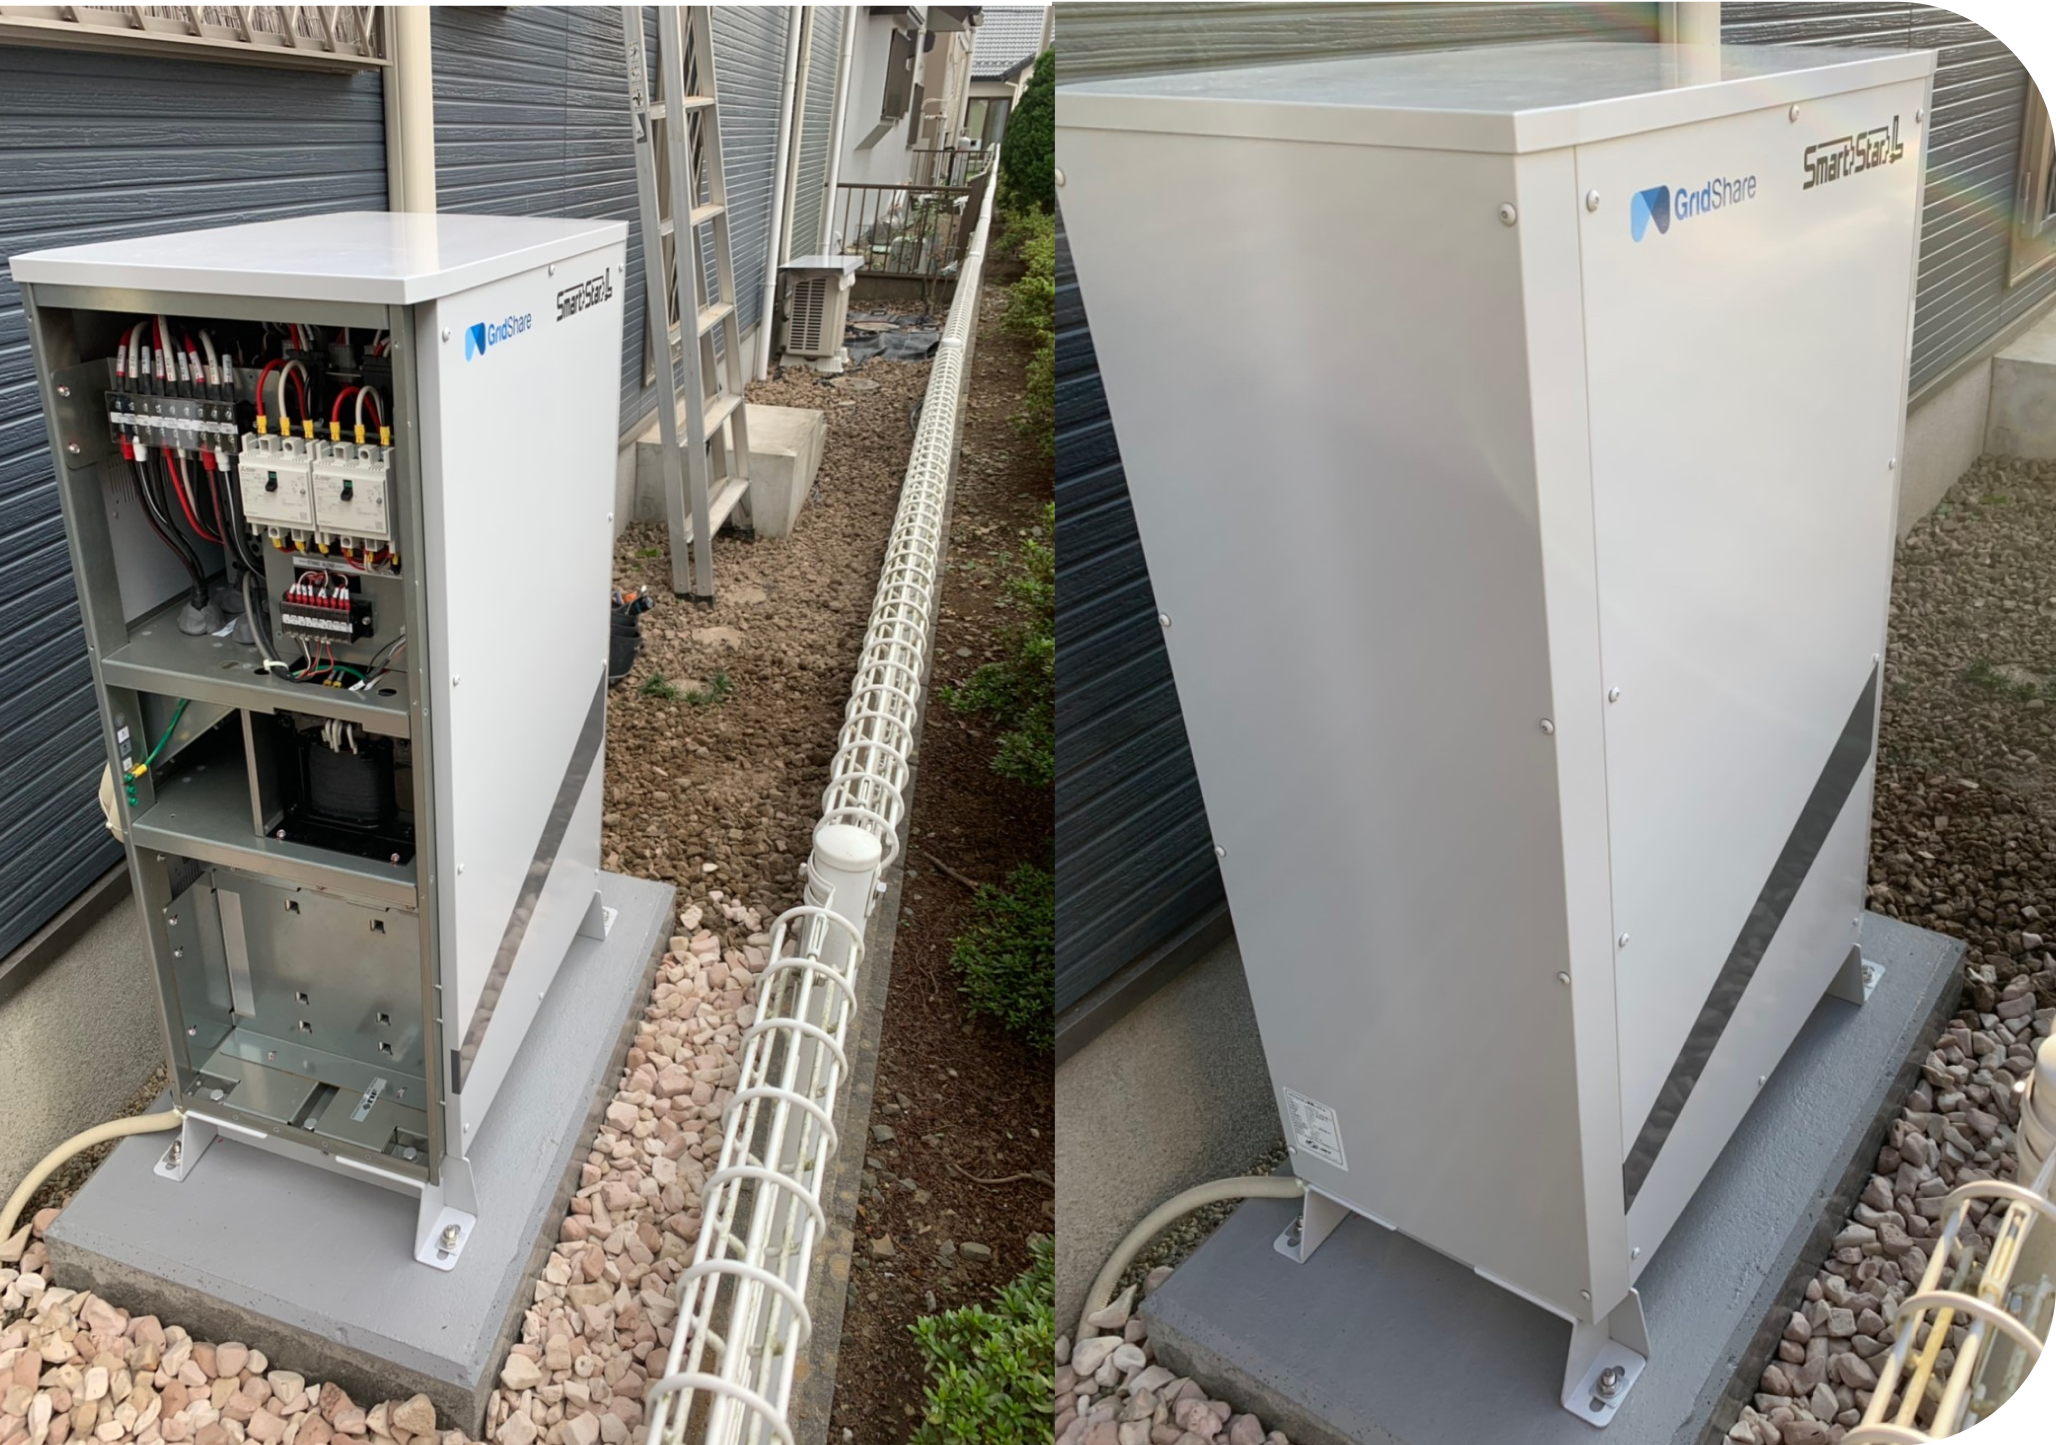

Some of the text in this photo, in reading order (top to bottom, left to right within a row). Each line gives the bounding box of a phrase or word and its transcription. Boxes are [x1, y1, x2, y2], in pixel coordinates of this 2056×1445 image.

[1803, 135, 1854, 190] Smart
[1854, 126, 1890, 173] Star
[1674, 174, 1757, 221] GridShare
[556, 283, 585, 322] Smart
[585, 275, 605, 309] Star
[488, 313, 532, 346] GridShare
